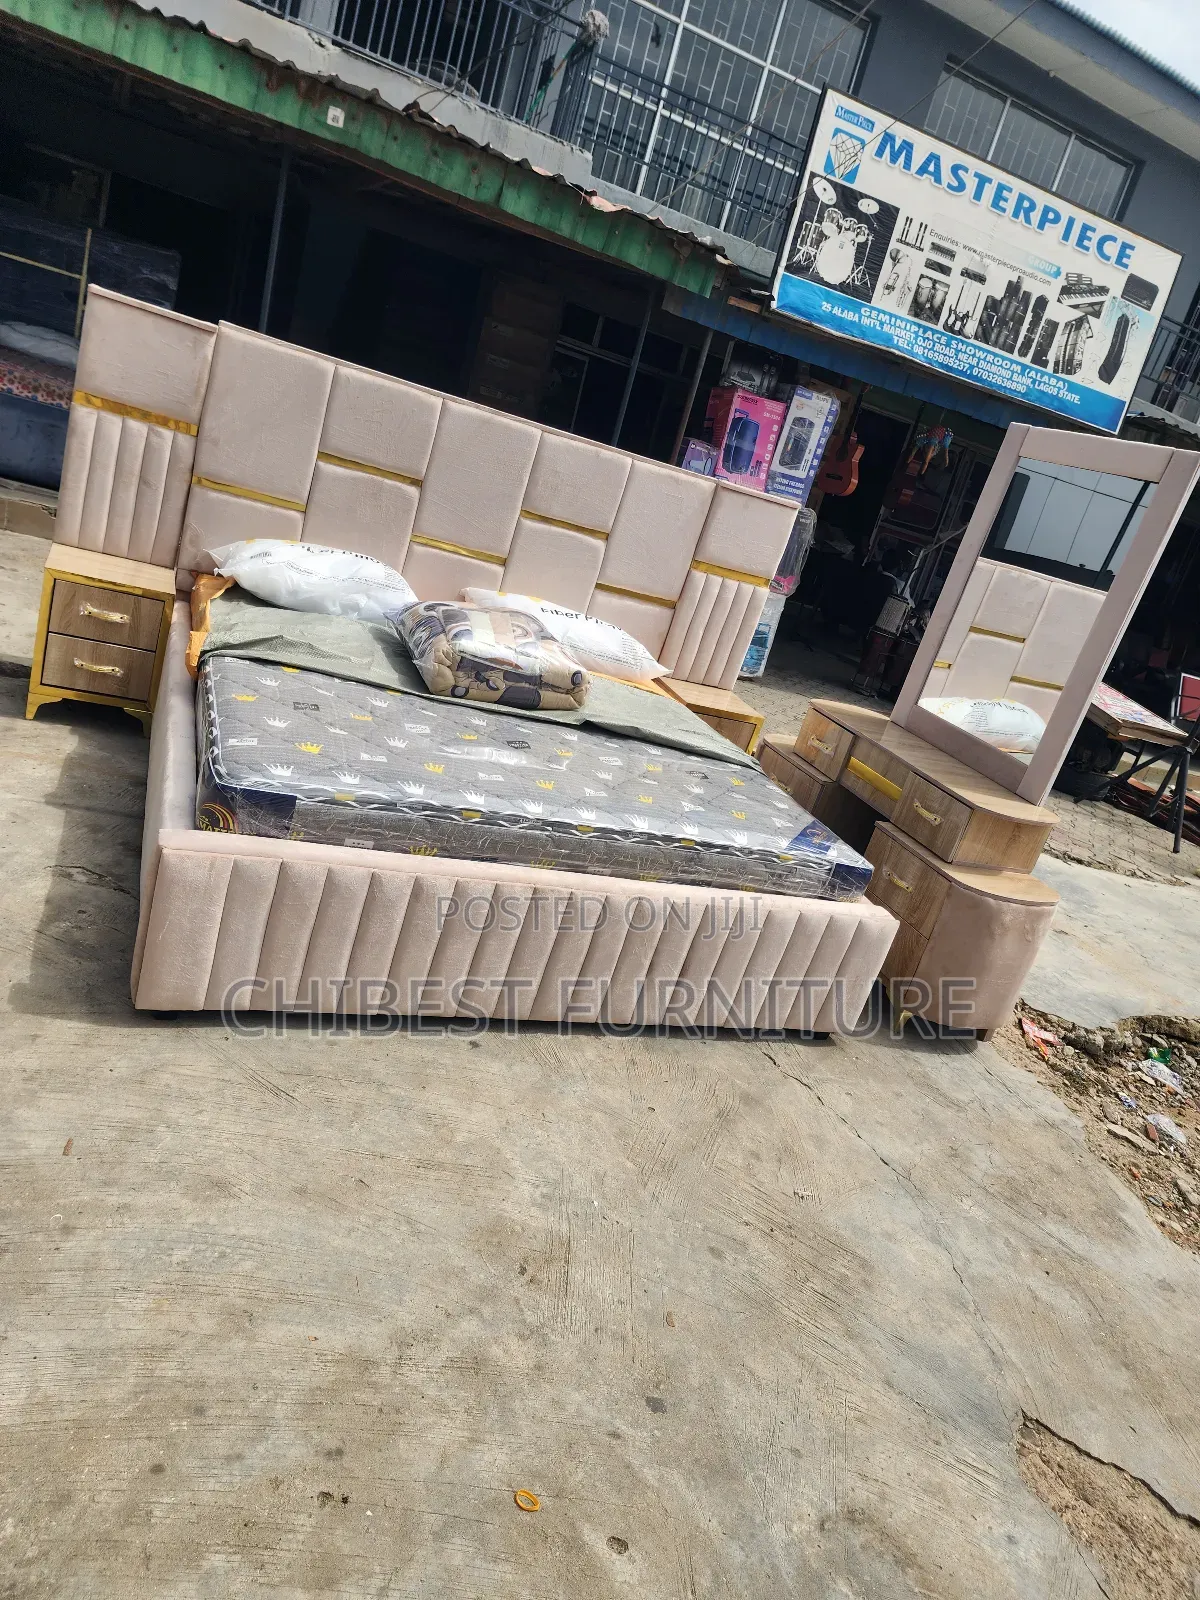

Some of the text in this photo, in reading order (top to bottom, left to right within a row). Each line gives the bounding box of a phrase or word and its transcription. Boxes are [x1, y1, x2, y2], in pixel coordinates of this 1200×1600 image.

[873, 131, 1137, 271] MASTERPIECE
[929, 229, 962, 248] Enquiries:
[821, 301, 1080, 404] 25 ALABA INT'L MARKET, OJO ROAD, NEAR DIAMOND BANK, LAGOS STATE.
[861, 306, 1068, 391] GEMINIPLACE SHOWROOM (ALABA)
[893, 335, 1027, 393] TEL: 08165895237, 07032636890
